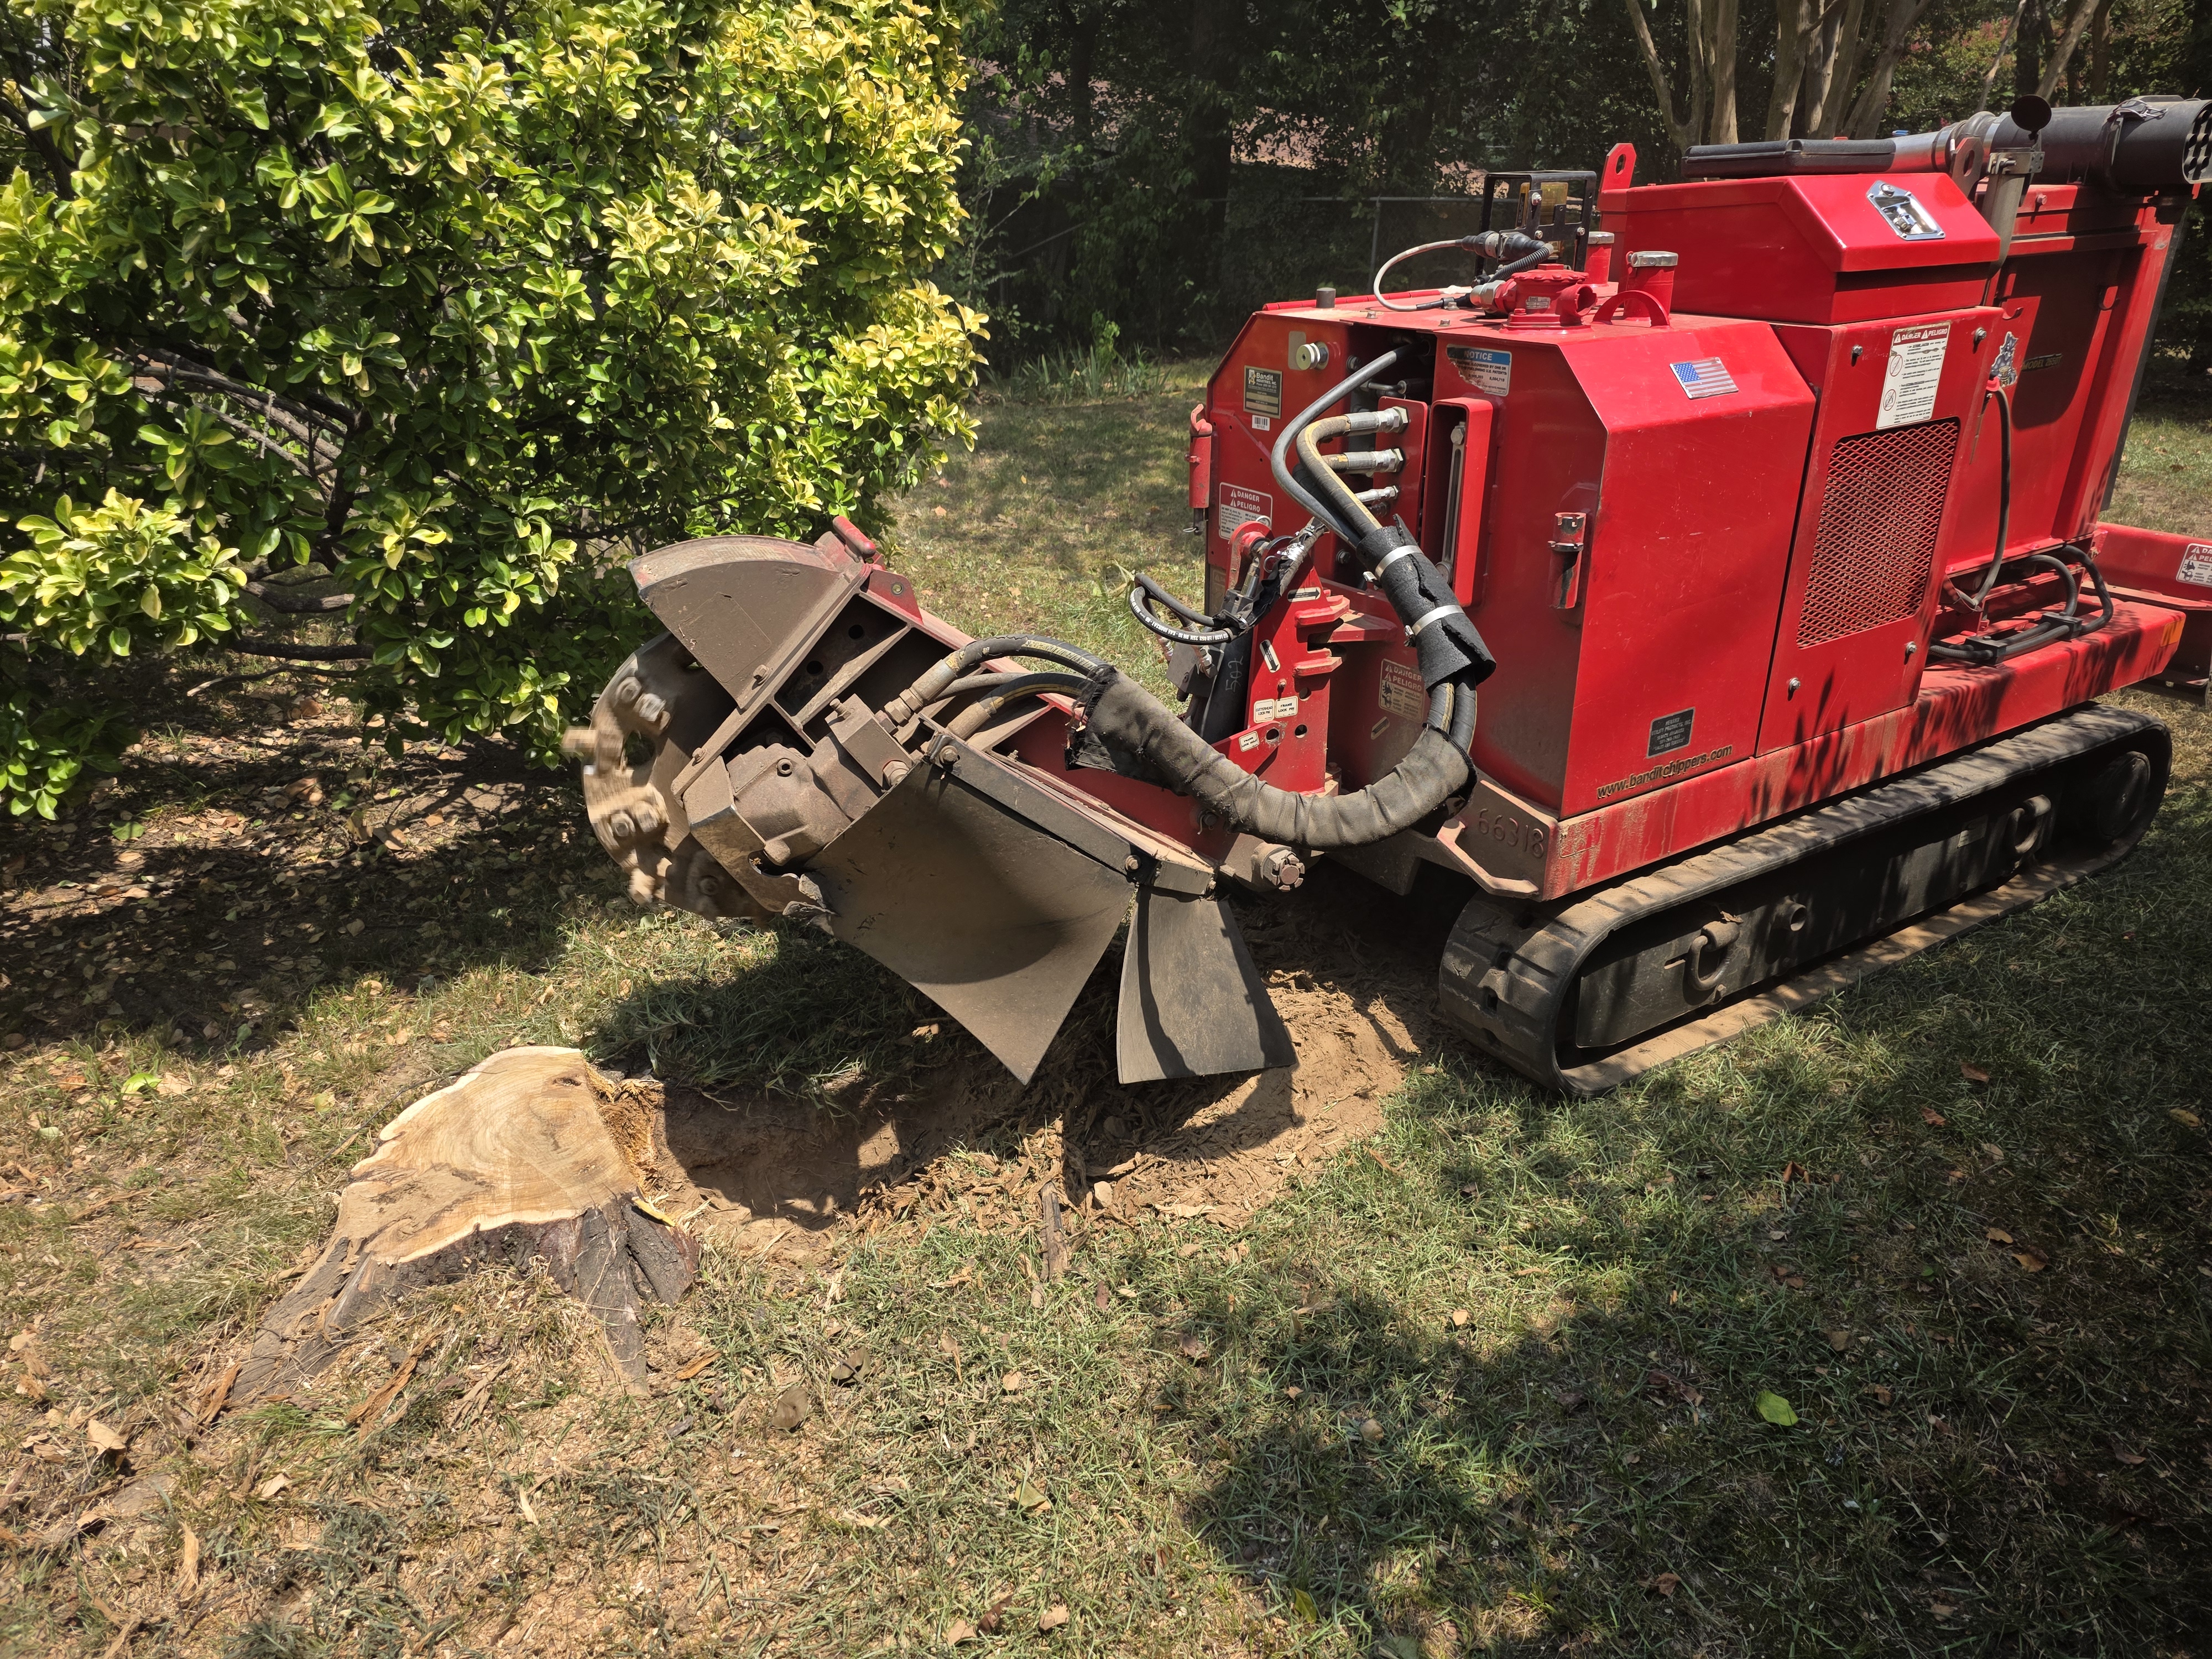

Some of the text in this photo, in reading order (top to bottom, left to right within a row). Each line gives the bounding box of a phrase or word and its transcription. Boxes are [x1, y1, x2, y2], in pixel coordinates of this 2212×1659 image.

[1928, 328, 1948, 336] PELIGRO
[1464, 351, 1493, 361] NOTICE
[2021, 359, 2043, 369] MODEL
[1256, 373, 1273, 381] Bandit
[1237, 491, 1260, 503] DANGER
[1237, 500, 1260, 513] PELIGRO
[1394, 666, 1422, 682] DANGER
[1392, 675, 1422, 692] PELIGRO
[1597, 744, 1733, 799] www.banditchippers.com
[1479, 808, 1544, 858] 66318
